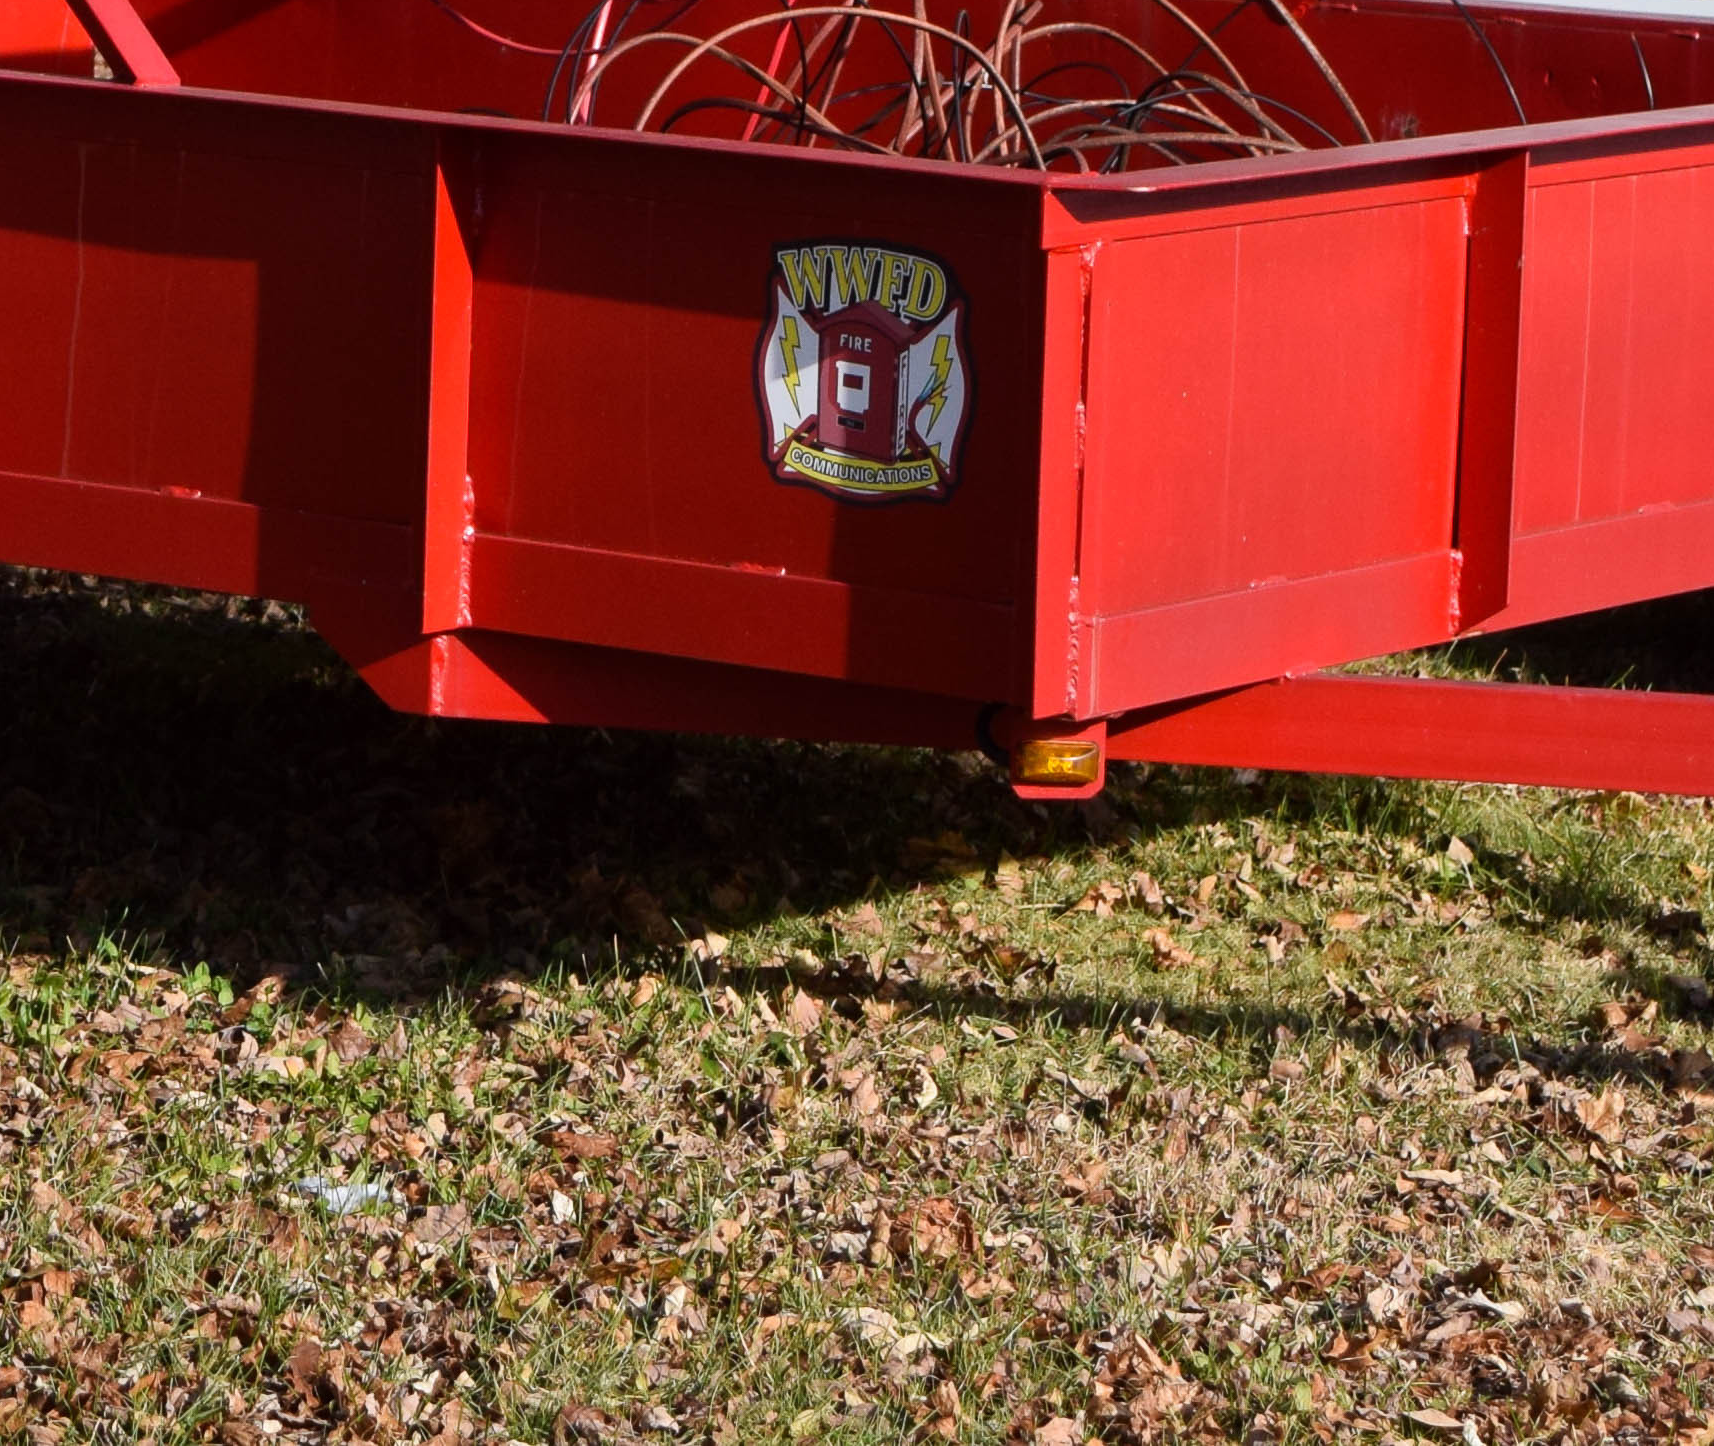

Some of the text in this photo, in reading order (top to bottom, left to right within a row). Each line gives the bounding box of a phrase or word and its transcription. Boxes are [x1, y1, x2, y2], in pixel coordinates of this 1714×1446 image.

[778, 246, 947, 321] WWFD
[839, 334, 872, 353] FIRE
[790, 448, 931, 483] COMMUNICATIONS
